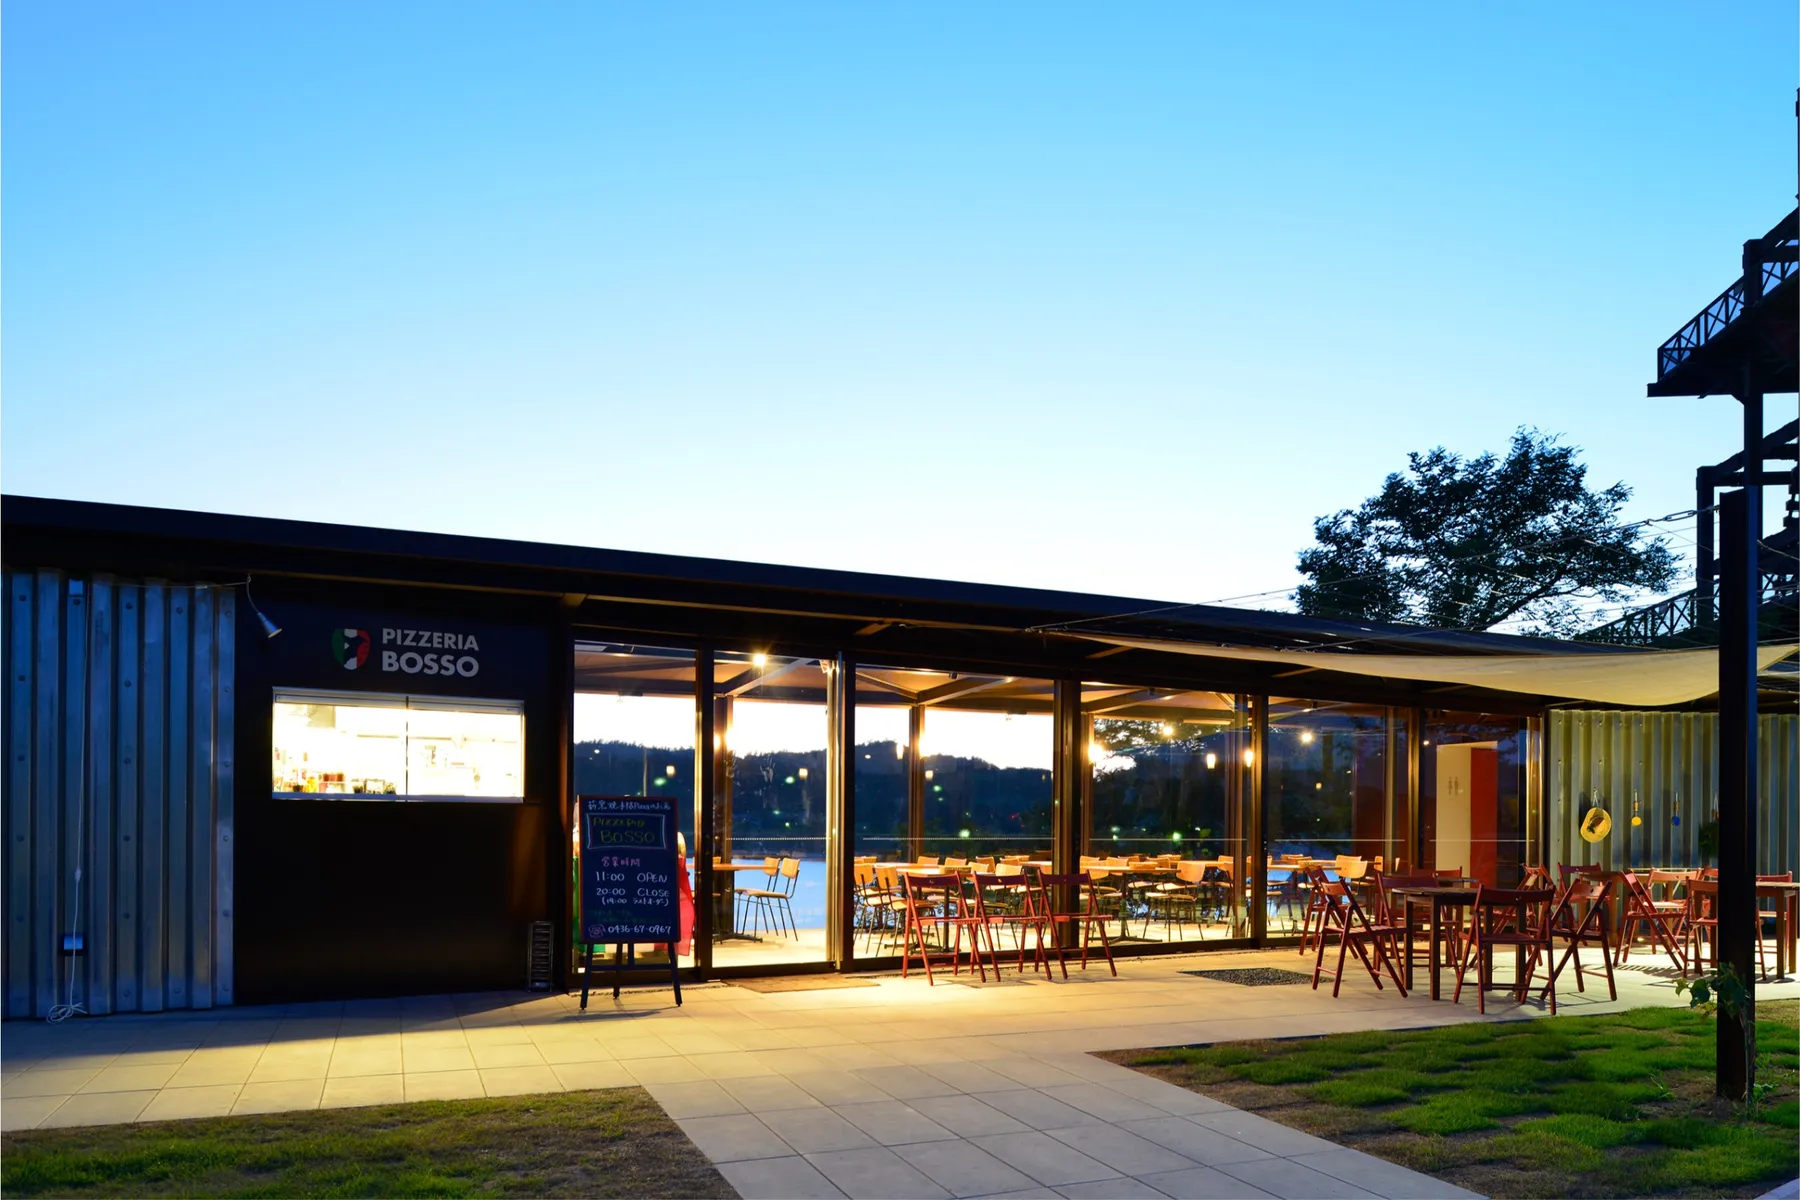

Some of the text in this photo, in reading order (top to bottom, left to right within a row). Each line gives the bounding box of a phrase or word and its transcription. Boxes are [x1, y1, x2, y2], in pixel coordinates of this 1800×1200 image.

[382, 628, 479, 650] PIZZERIA
[382, 650, 479, 677] BOSSO
[600, 829, 655, 844] BOSSO
[601, 856, 640, 867] 営業時間
[596, 871, 667, 883] 11:00 OPEN
[596, 887, 670, 897] 20:00 CLOSE
[607, 924, 671, 935] 0436-67-0967
